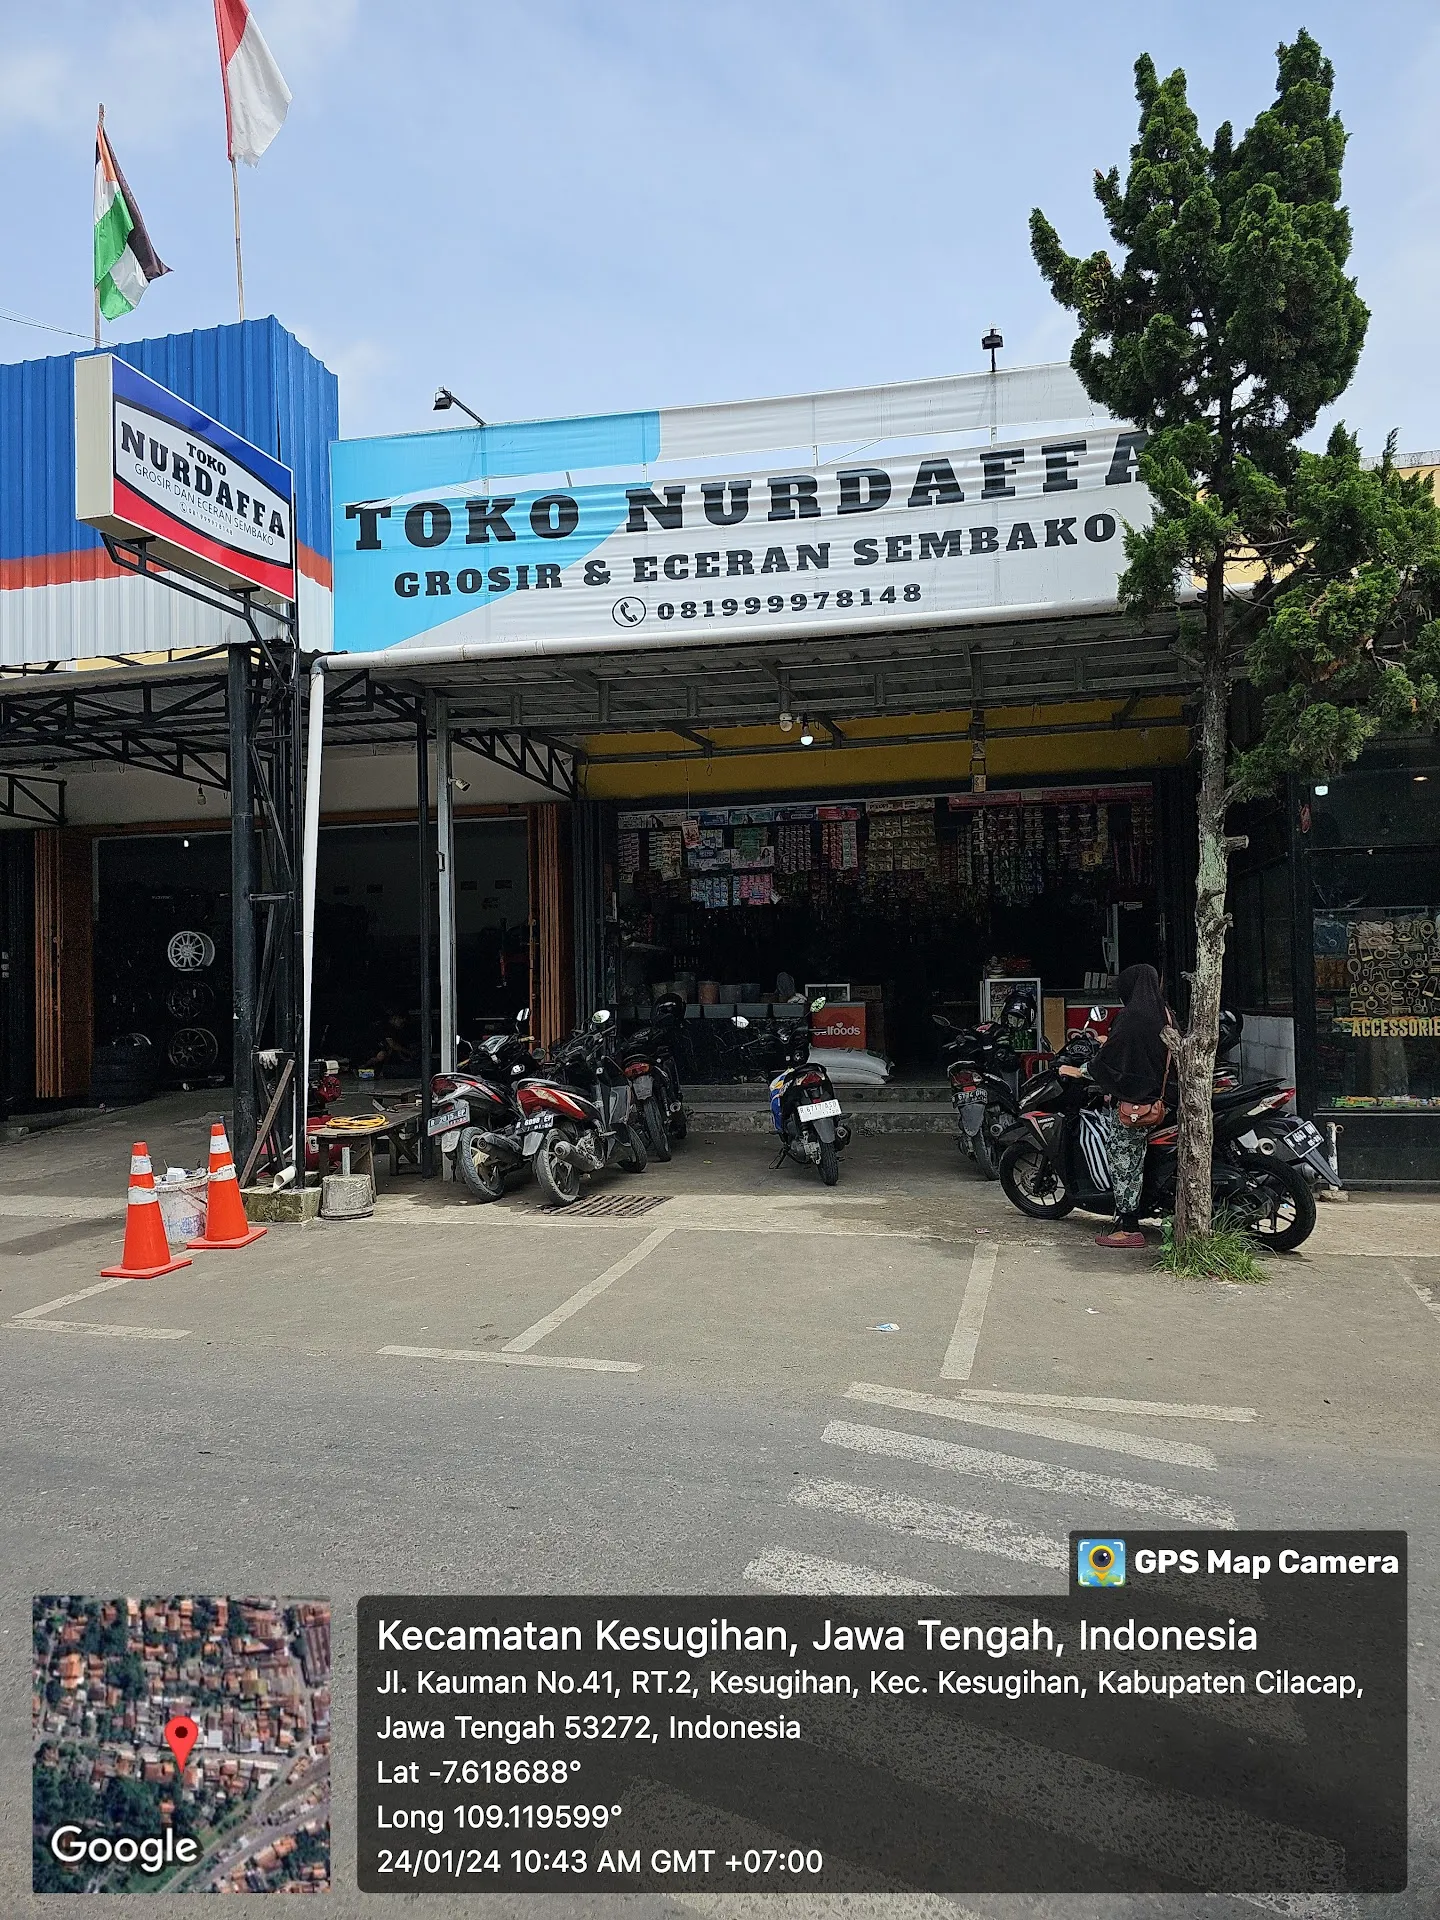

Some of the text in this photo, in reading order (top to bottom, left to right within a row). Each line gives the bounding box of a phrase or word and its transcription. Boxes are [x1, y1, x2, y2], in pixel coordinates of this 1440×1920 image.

[121, 421, 286, 540] NURDAFFA
[186, 441, 227, 476] TOKO
[345, 431, 1148, 551] TOKO NURDAFFA
[134, 463, 274, 547] GROSIR DAN ECERAN SEMBAKO
[394, 513, 1117, 599] GROSIR & ECERAN SEMBAKO
[657, 583, 922, 620] 081999978148
